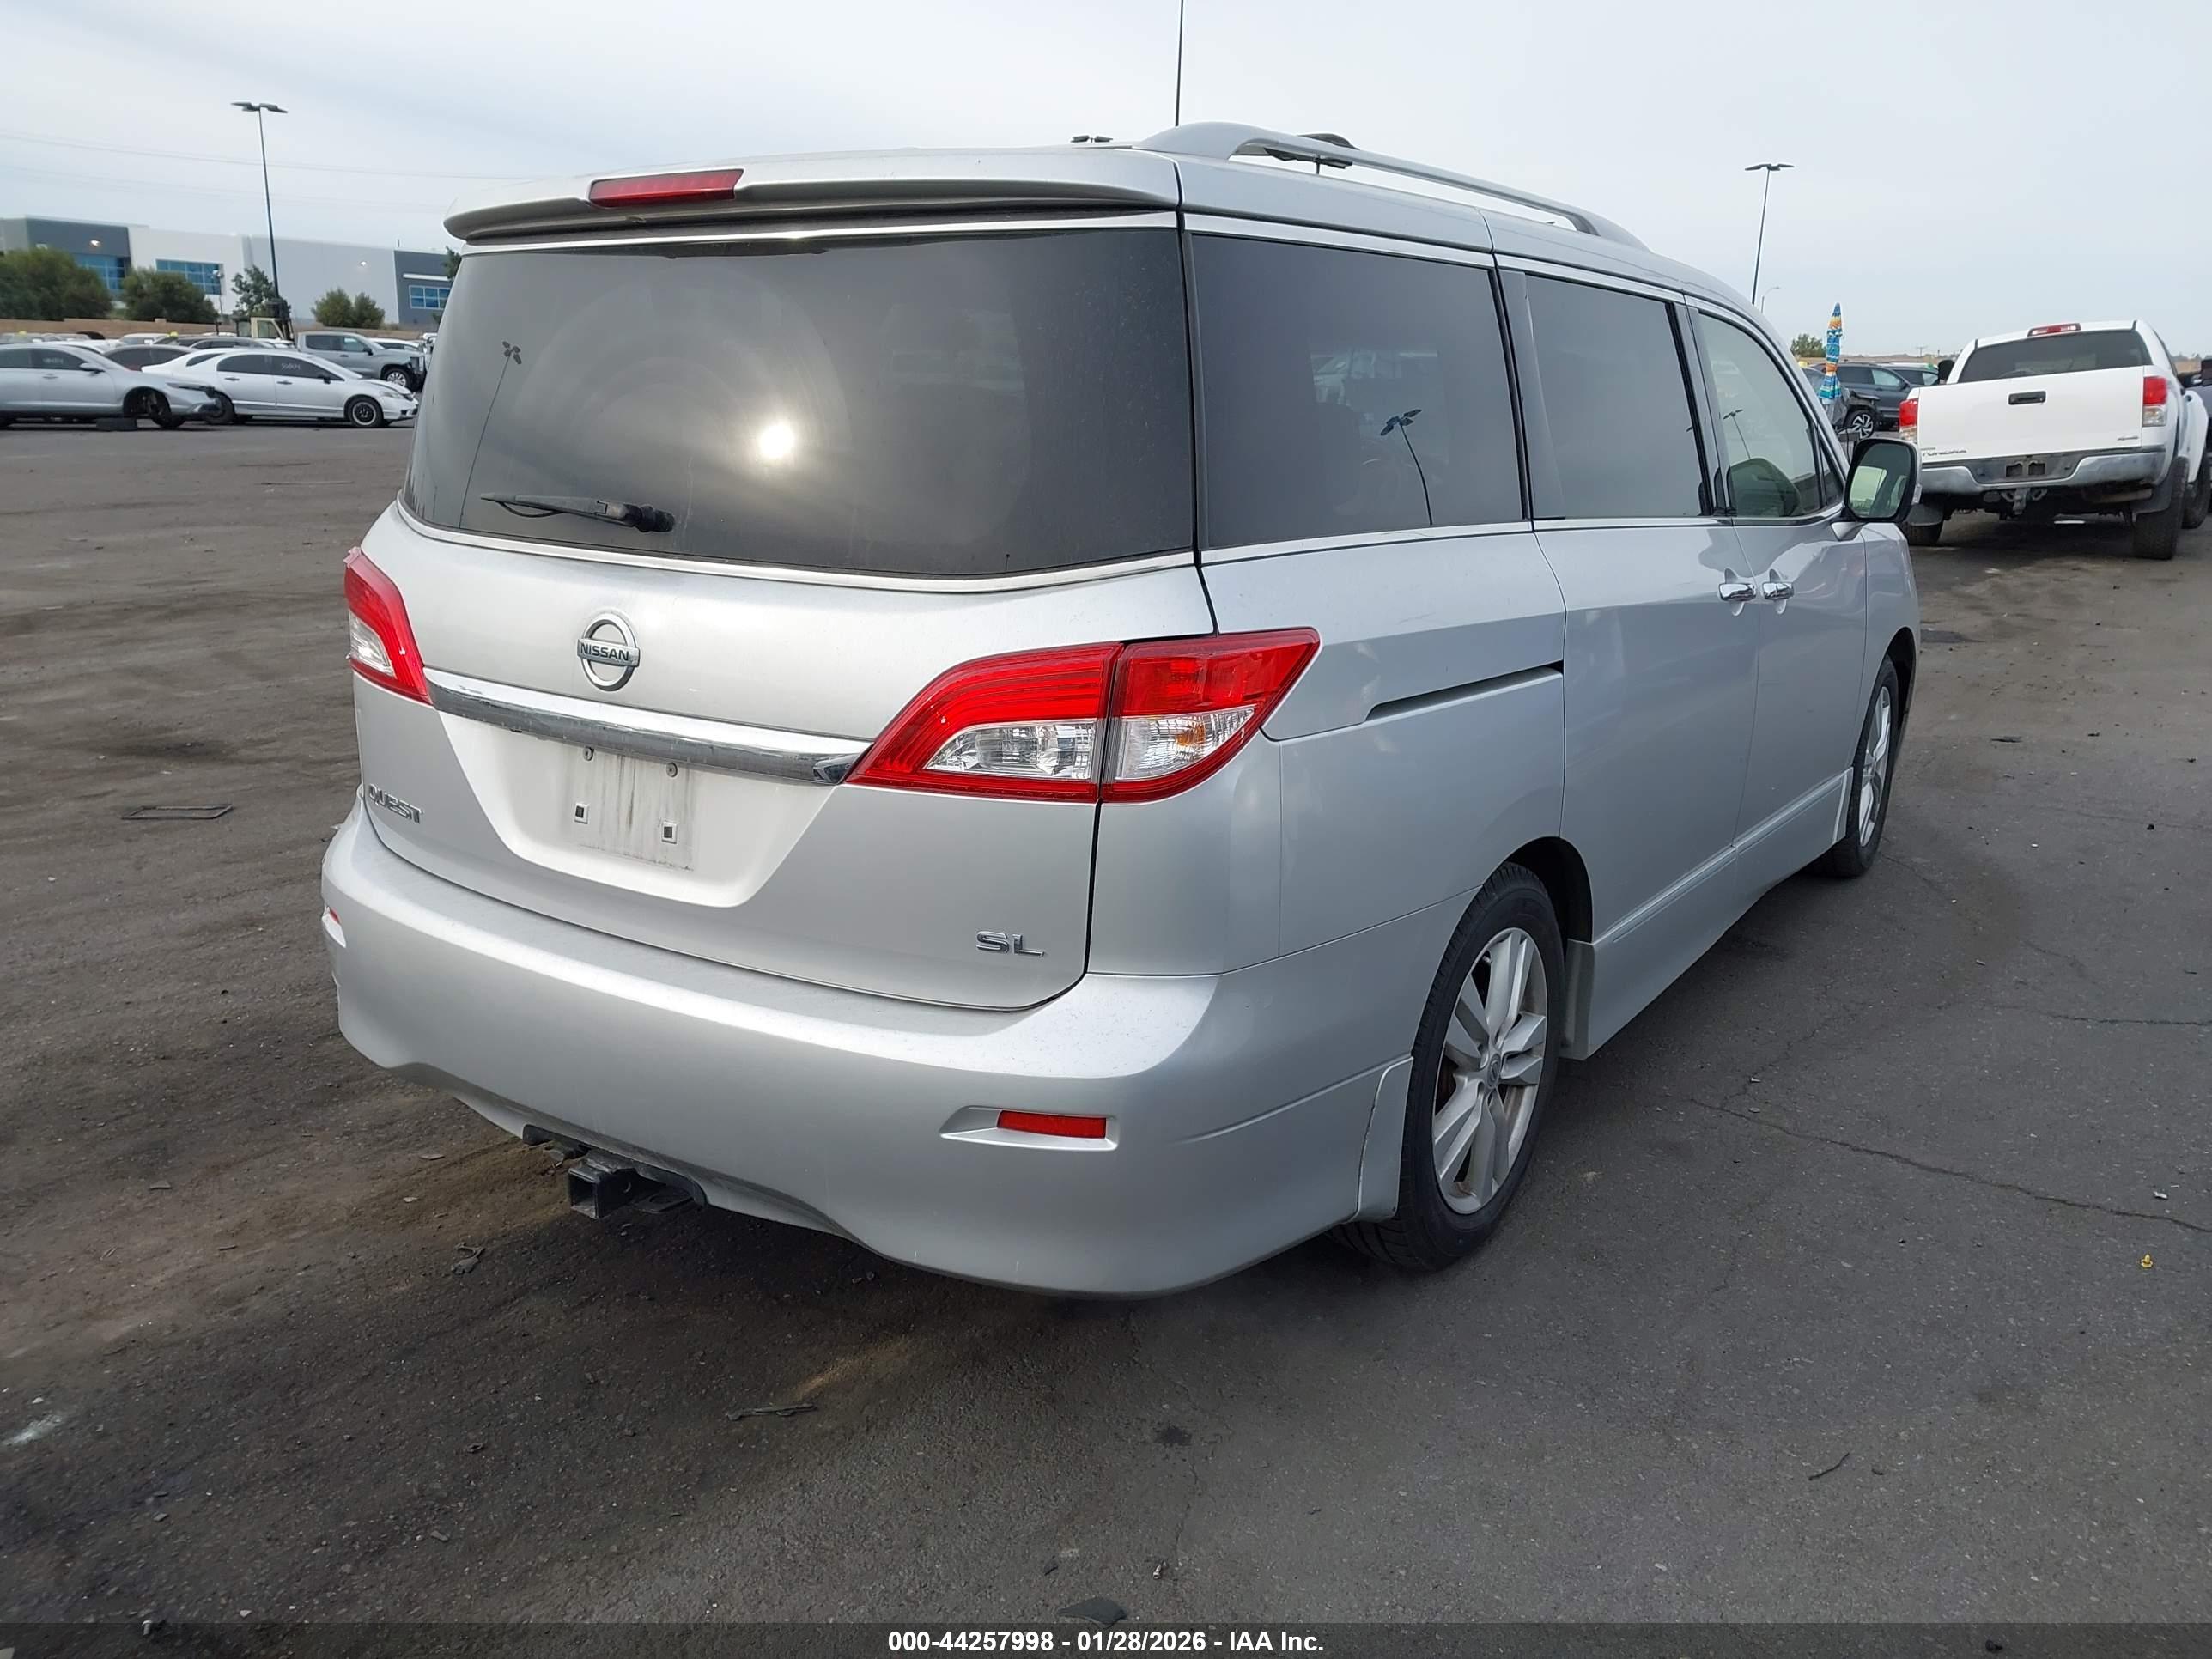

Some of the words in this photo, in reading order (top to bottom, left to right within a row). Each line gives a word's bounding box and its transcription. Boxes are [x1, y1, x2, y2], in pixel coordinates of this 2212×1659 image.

[580, 643, 630, 662] NISSAN
[368, 782, 423, 824] QUEST
[975, 930, 1046, 957] SL
